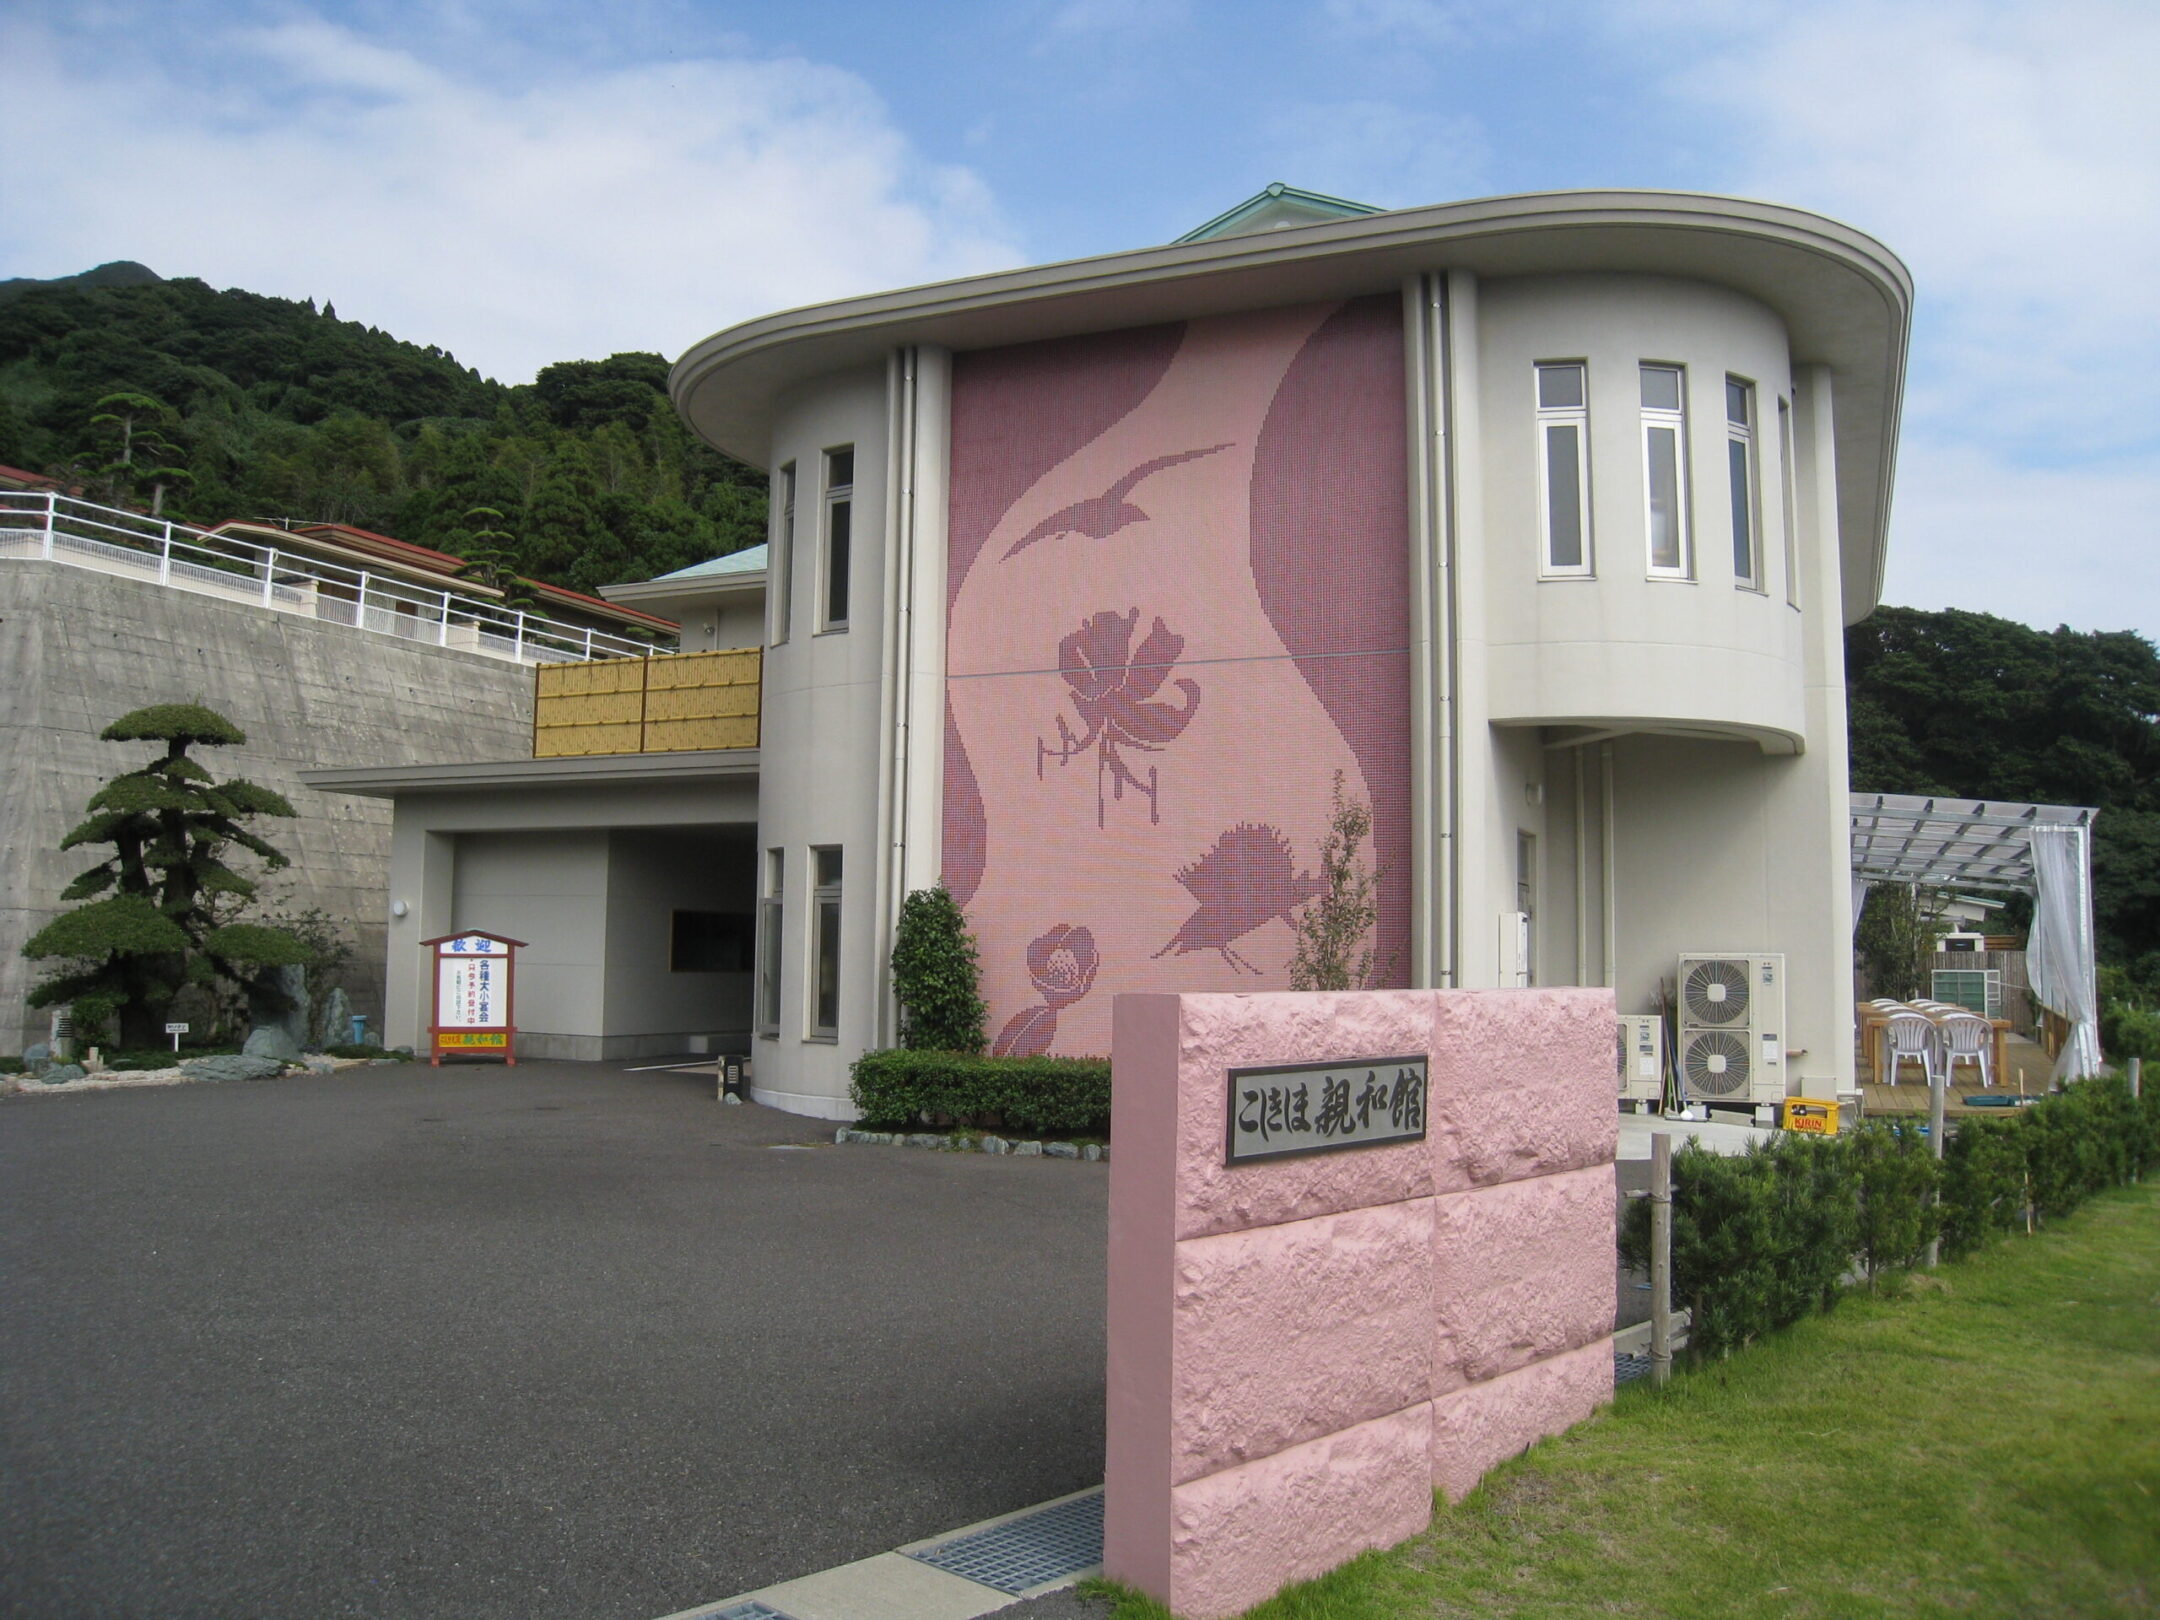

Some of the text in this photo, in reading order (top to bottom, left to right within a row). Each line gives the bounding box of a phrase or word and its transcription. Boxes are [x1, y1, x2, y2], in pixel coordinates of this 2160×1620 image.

[452, 939, 492, 953] 歓迎
[479, 960, 490, 1023] 各種大小宴会
[1795, 1118, 1822, 1128] KIRIN
